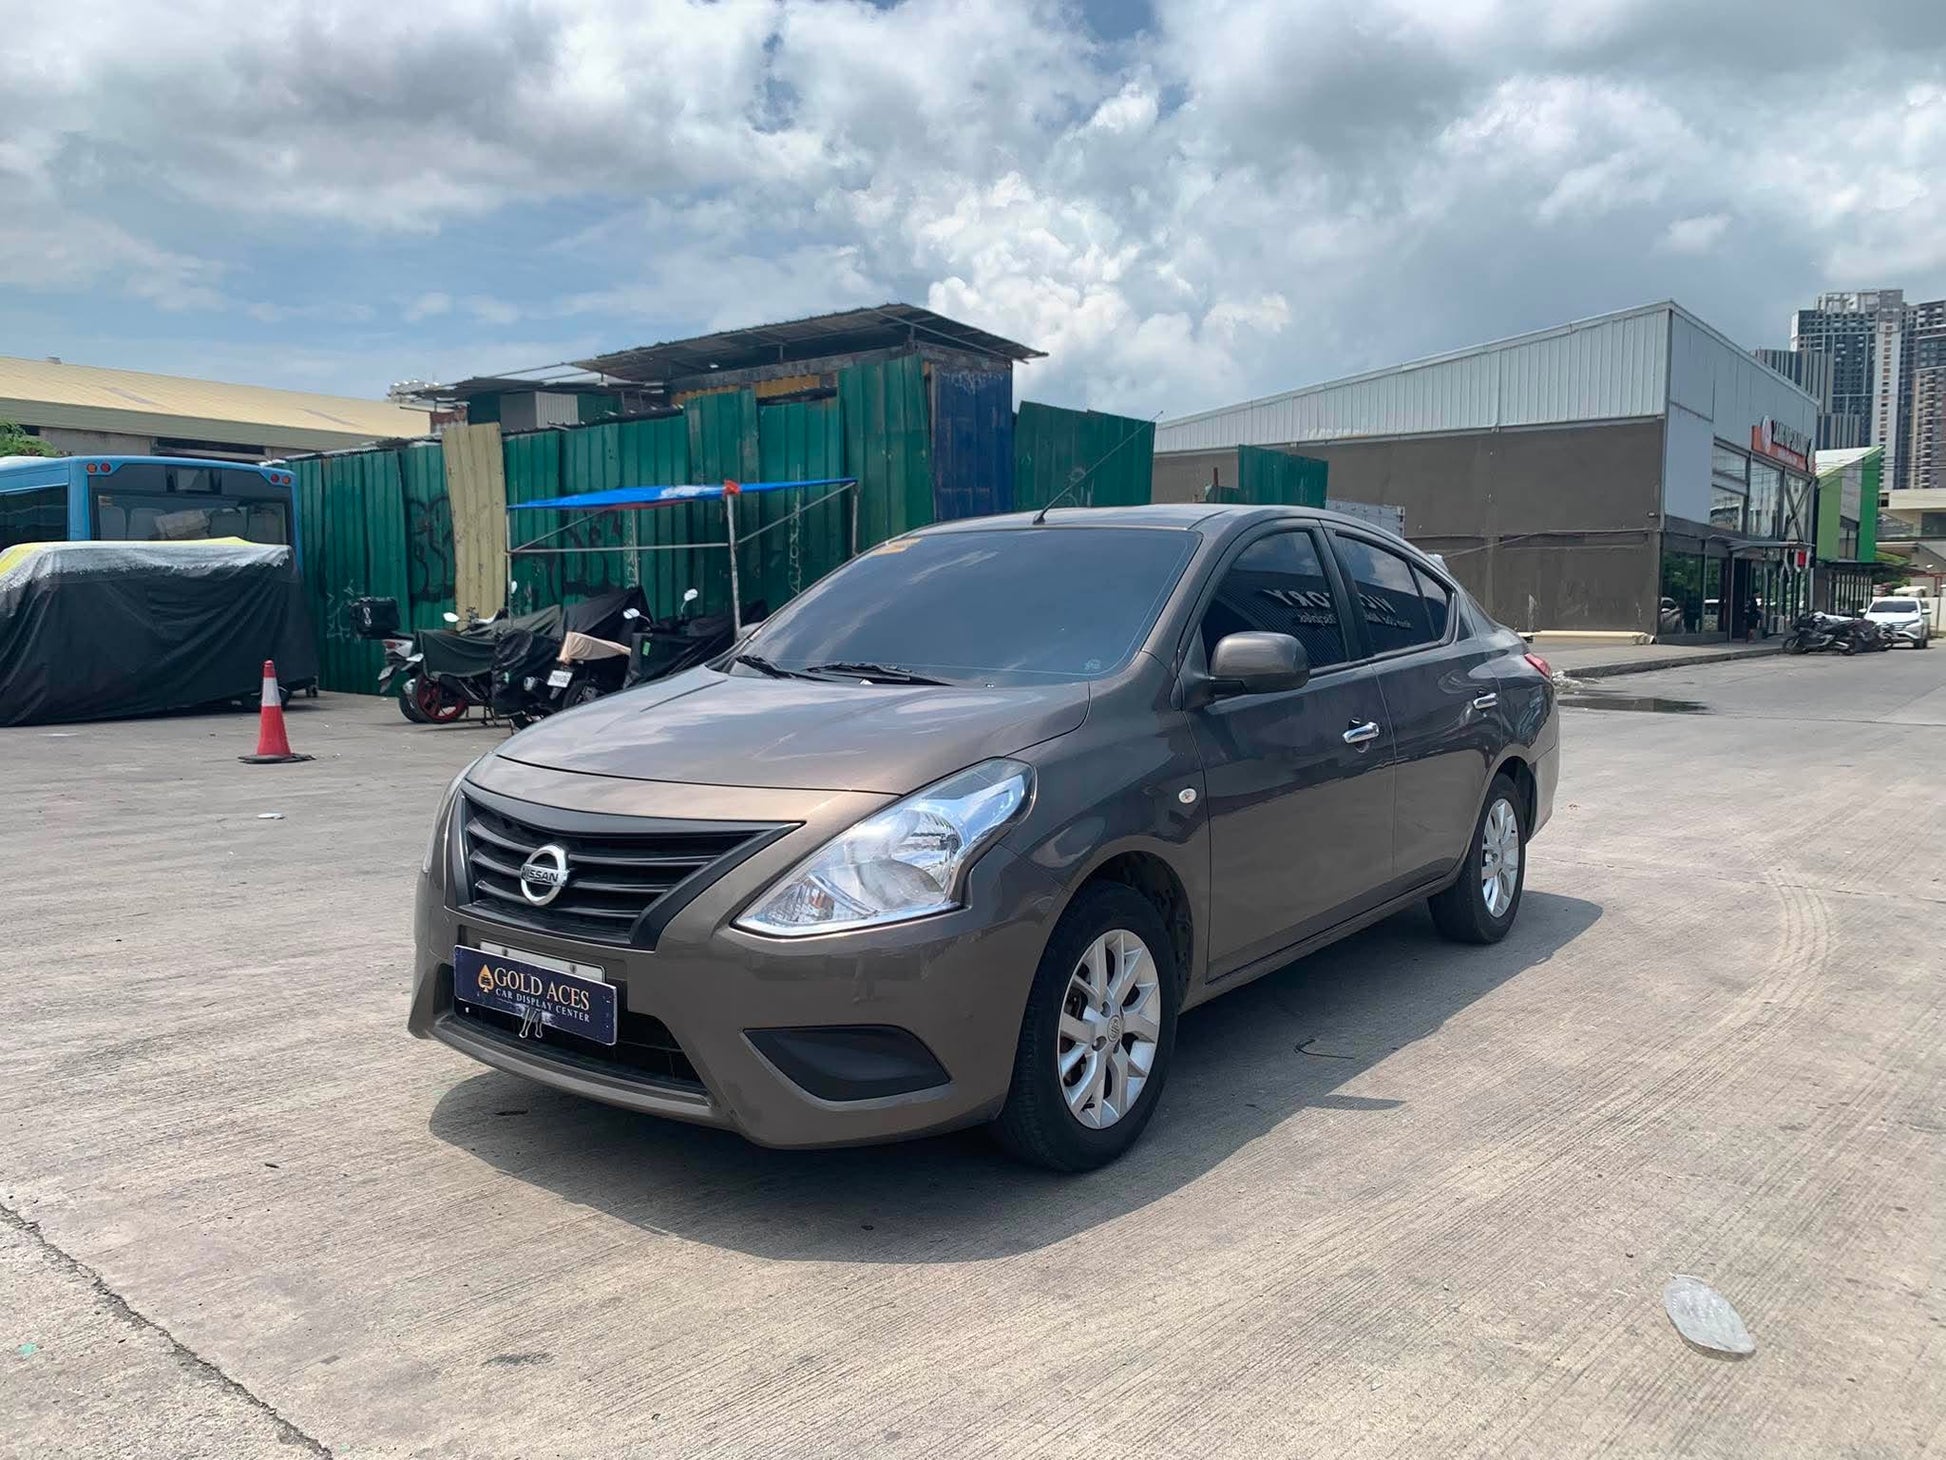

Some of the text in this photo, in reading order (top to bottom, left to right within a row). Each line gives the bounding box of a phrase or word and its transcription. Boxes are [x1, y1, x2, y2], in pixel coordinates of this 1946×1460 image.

[521, 866, 559, 883] NISSAN
[494, 967, 590, 1010] GOLD ACES
[495, 988, 590, 1023] CAR DISPLAY CENTER
